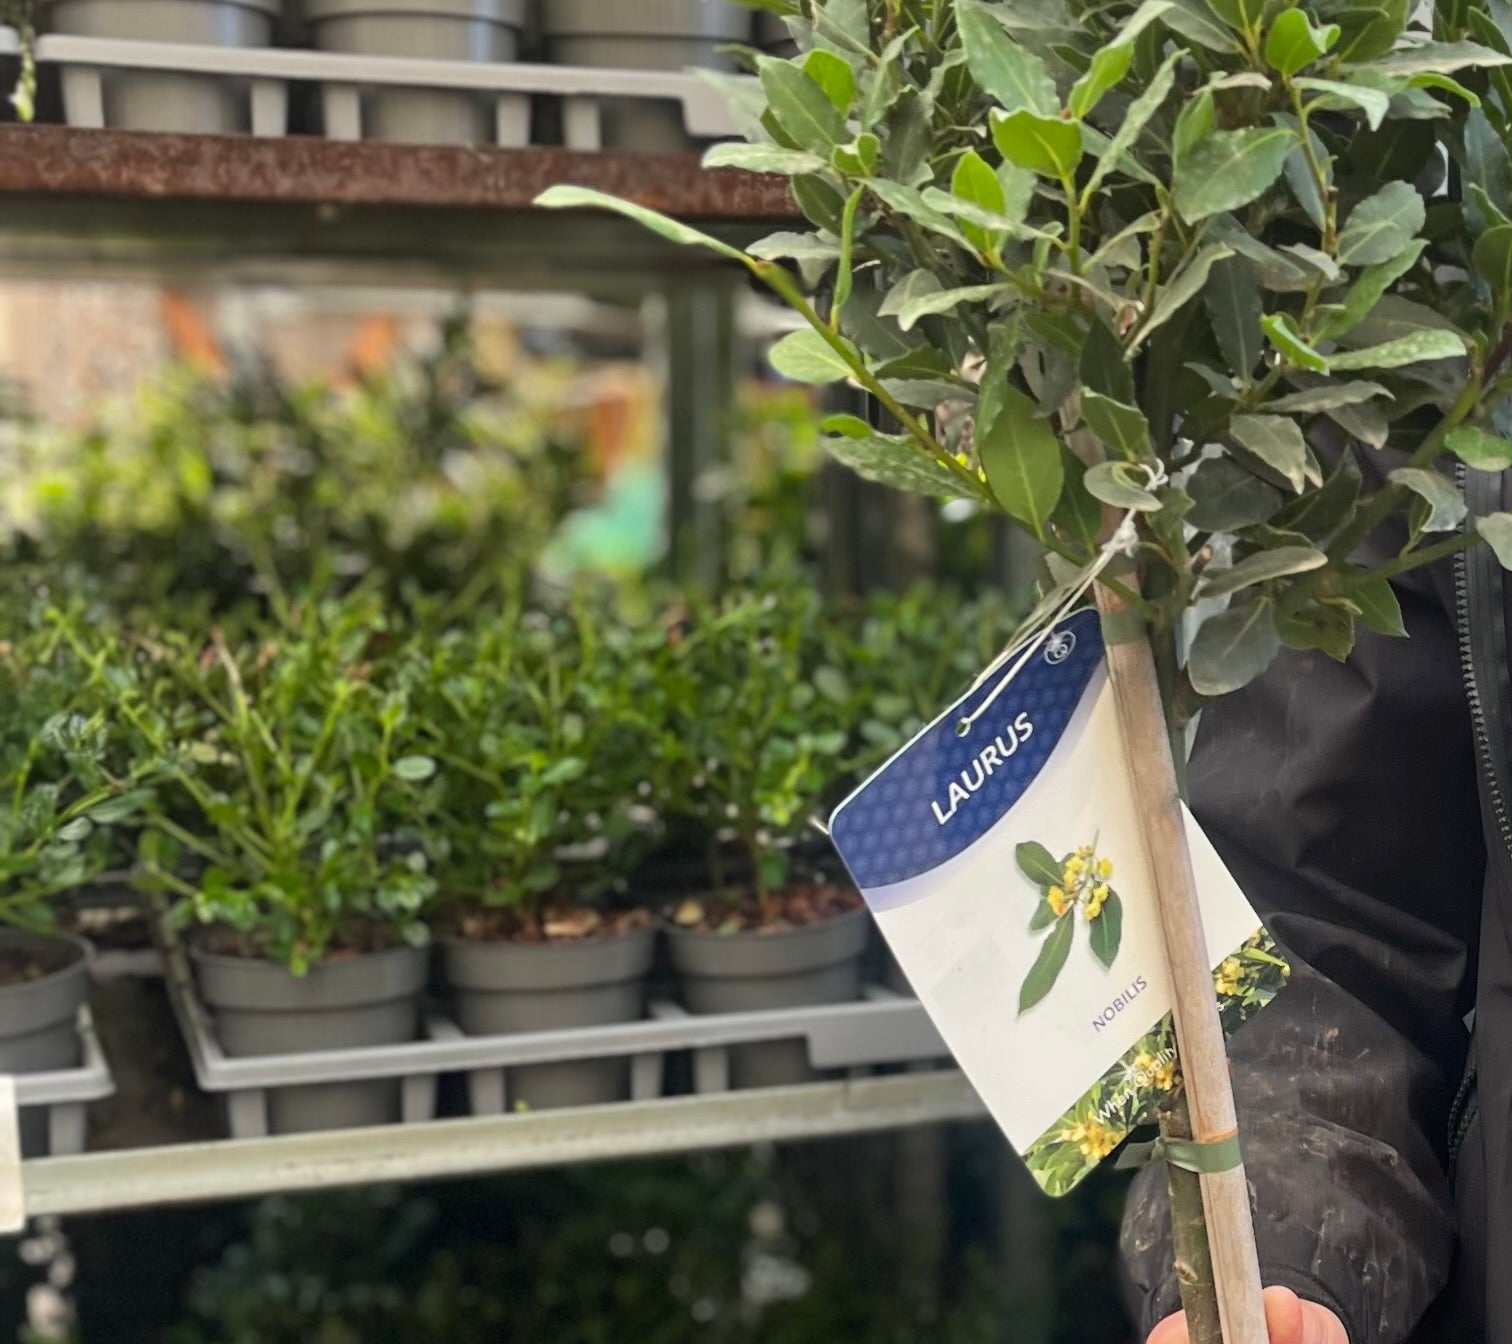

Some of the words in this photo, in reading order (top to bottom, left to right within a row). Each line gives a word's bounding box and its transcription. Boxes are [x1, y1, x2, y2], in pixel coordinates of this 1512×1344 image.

[931, 712, 1033, 825] LAURUS
[1092, 976, 1147, 1032] NOBILIS
[1093, 1086, 1136, 1124] When
[1134, 1047, 1178, 1087] Quality
